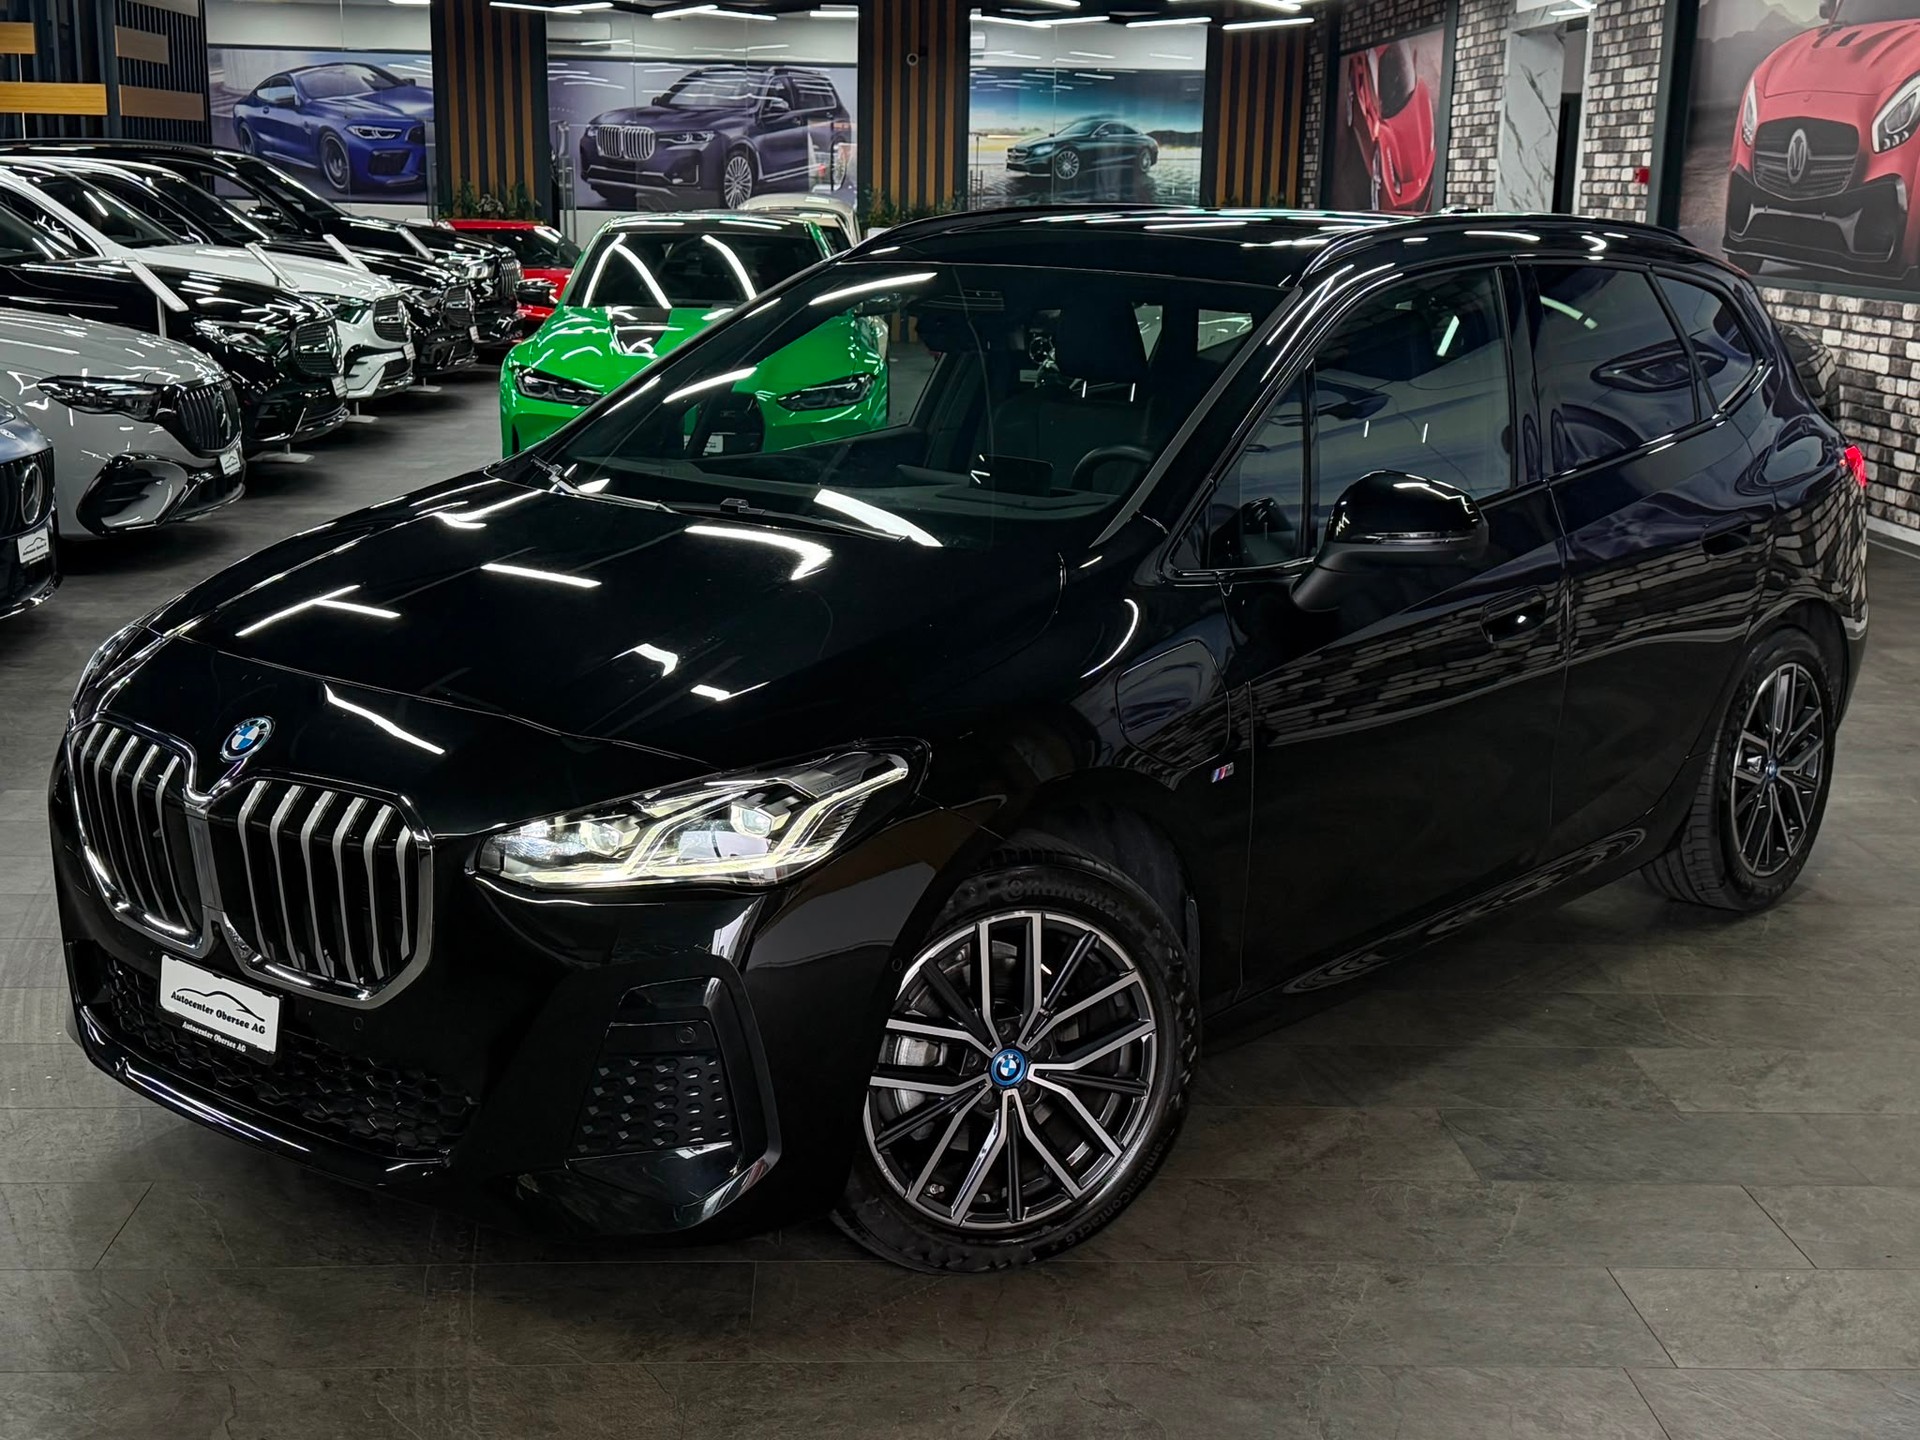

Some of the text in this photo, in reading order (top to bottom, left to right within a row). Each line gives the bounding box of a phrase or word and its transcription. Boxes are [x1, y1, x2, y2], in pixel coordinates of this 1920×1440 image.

[171, 991, 266, 1035] Autocenter Obersee AG
[182, 1021, 247, 1053] Autocenter Obersee AG
